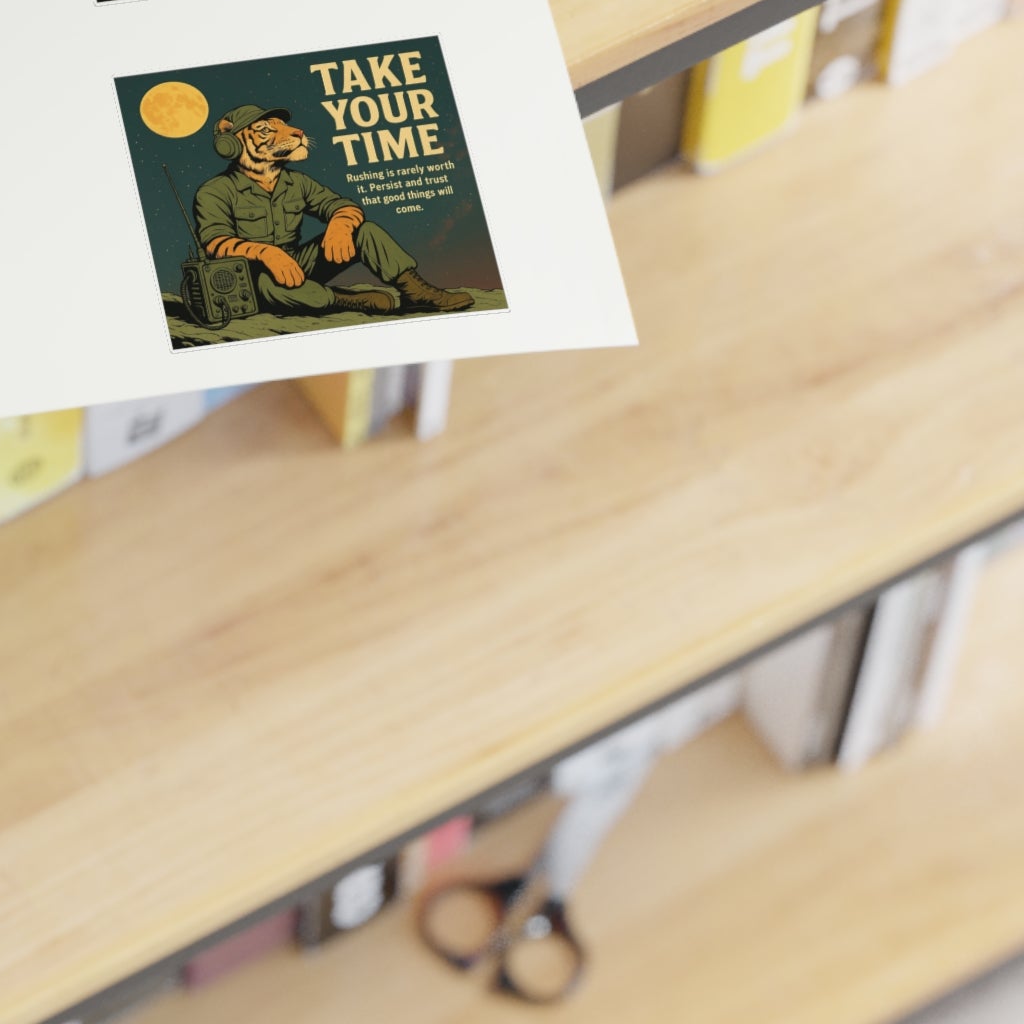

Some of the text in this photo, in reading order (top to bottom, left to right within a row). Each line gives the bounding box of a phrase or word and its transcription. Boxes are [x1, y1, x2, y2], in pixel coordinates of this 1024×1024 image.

[310, 51, 426, 95] TAKE
[320, 89, 439, 130] YOUR
[332, 123, 444, 166] TIME
[346, 160, 455, 183] Rushing is rarely worth
[357, 175, 448, 194] it. Persist and trust
[362, 186, 453, 206] that good things will
[396, 204, 424, 214] come.
